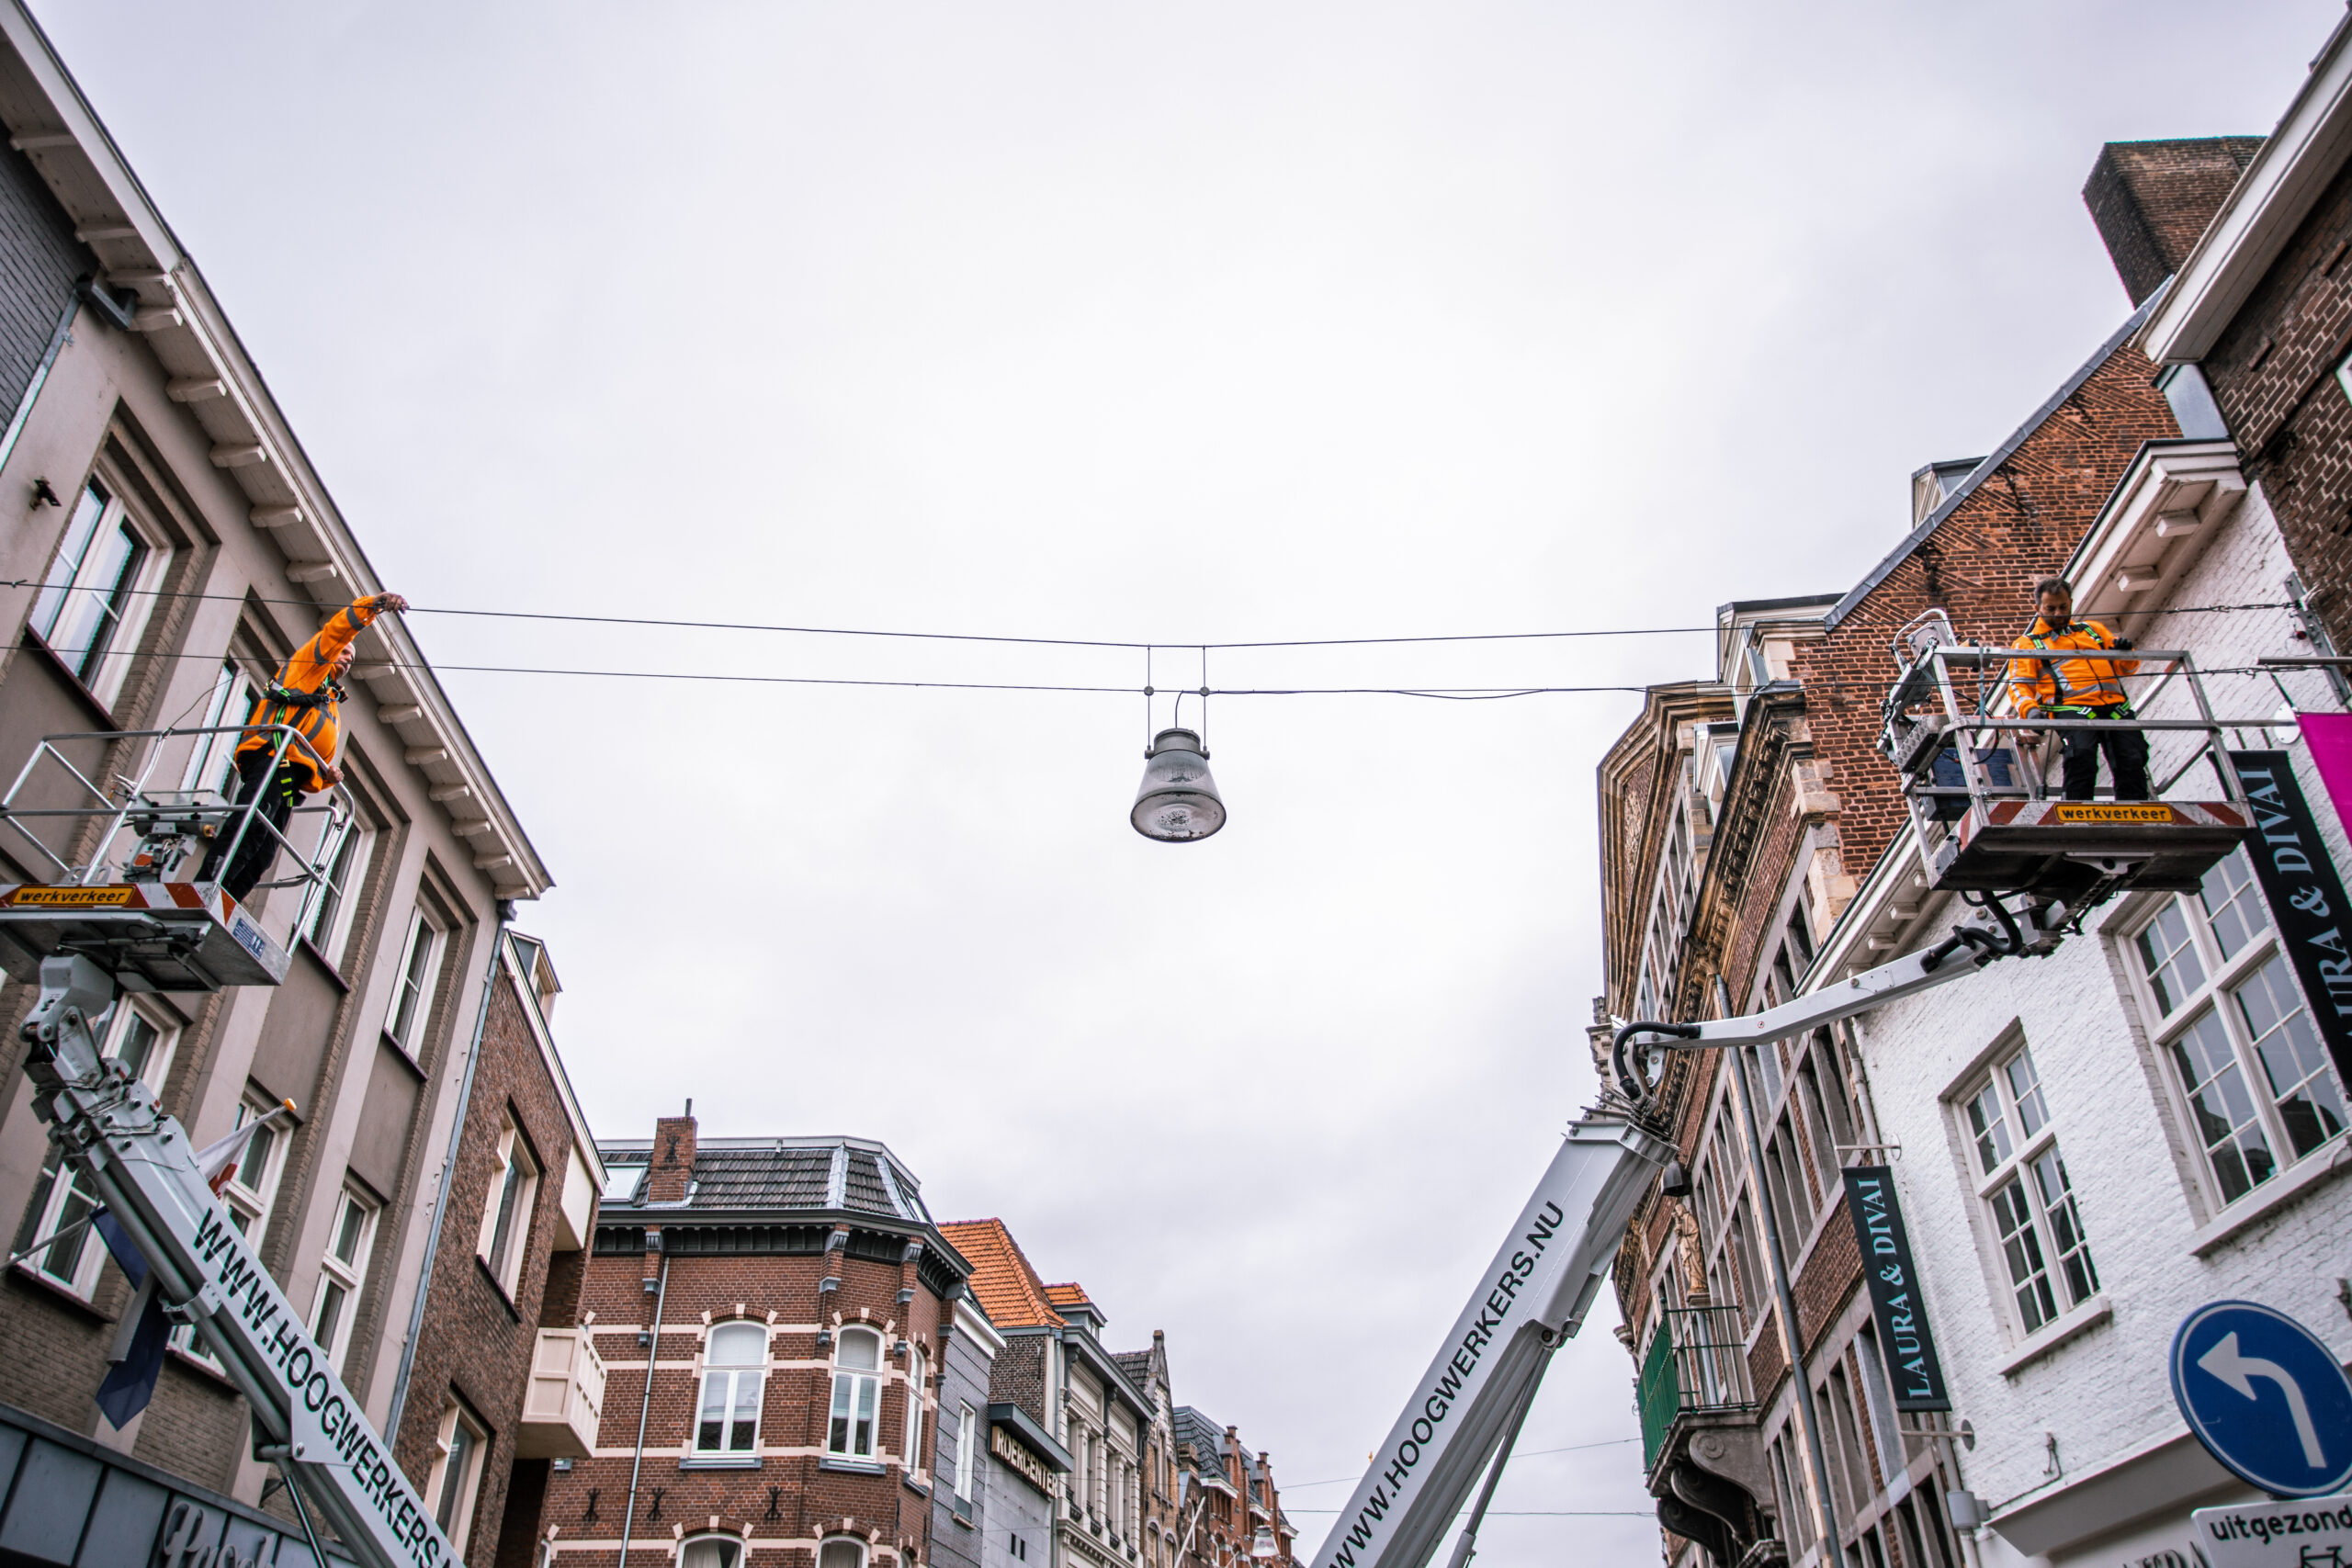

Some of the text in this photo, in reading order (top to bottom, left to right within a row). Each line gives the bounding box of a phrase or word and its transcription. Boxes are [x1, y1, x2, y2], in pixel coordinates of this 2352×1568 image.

[2062, 808, 2166, 819] werkverkeer
[20, 891, 125, 903] werkverkeer
[2236, 768, 2352, 1037] URA & DIVAI
[1857, 1178, 1933, 1398] LAURA & DIVAI
[193, 1207, 451, 1568] WWW.HOOGWERKERS
[1329, 1200, 1564, 1568] WWW.HOOGWERKERS.NU
[996, 1427, 1057, 1499] ROERCENTER
[2210, 1504, 2352, 1545] uitgezond
